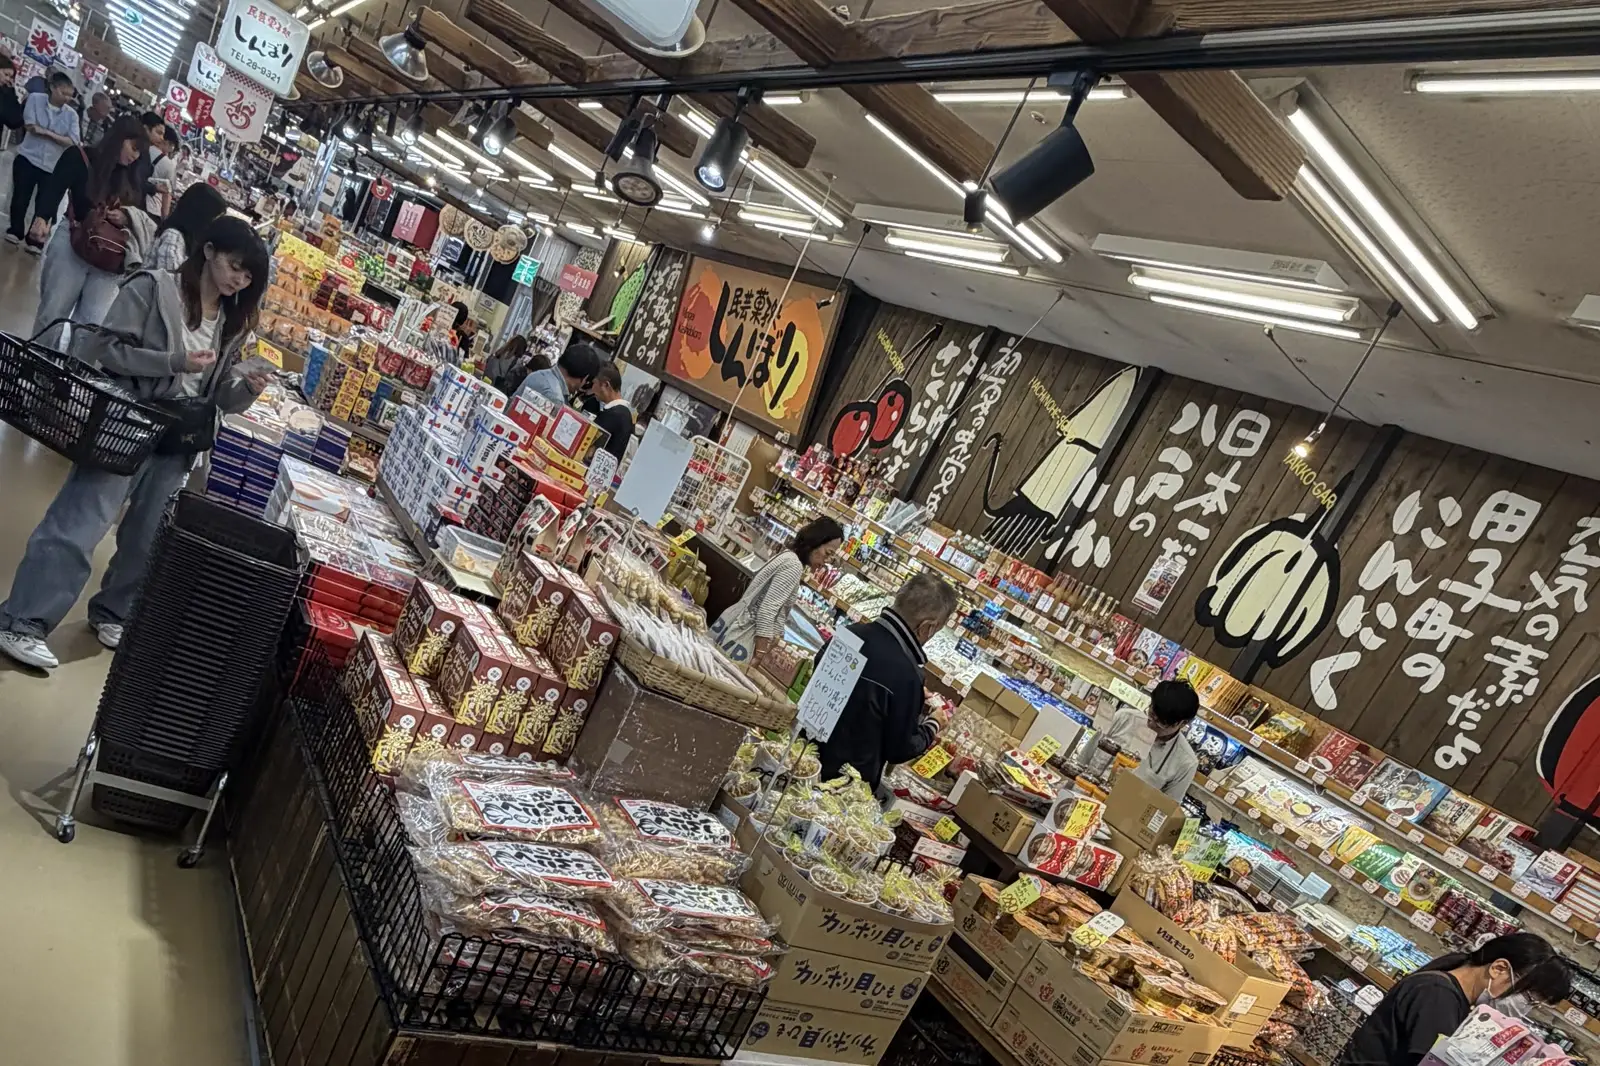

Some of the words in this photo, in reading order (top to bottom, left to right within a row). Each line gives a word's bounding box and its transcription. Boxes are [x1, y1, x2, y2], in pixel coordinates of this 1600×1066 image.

[235, 15, 293, 68] しんぼり
[709, 281, 800, 410] しんぼり
[1129, 401, 1200, 537] 八戸の
[1309, 490, 1463, 711] にんにく
[1401, 490, 1542, 694] 田子町の
[819, 911, 925, 951] カリポリ貝ひも
[792, 963, 896, 999] カリポリ貝ひも
[776, 1023, 878, 1053] カリポリ貝ひも
